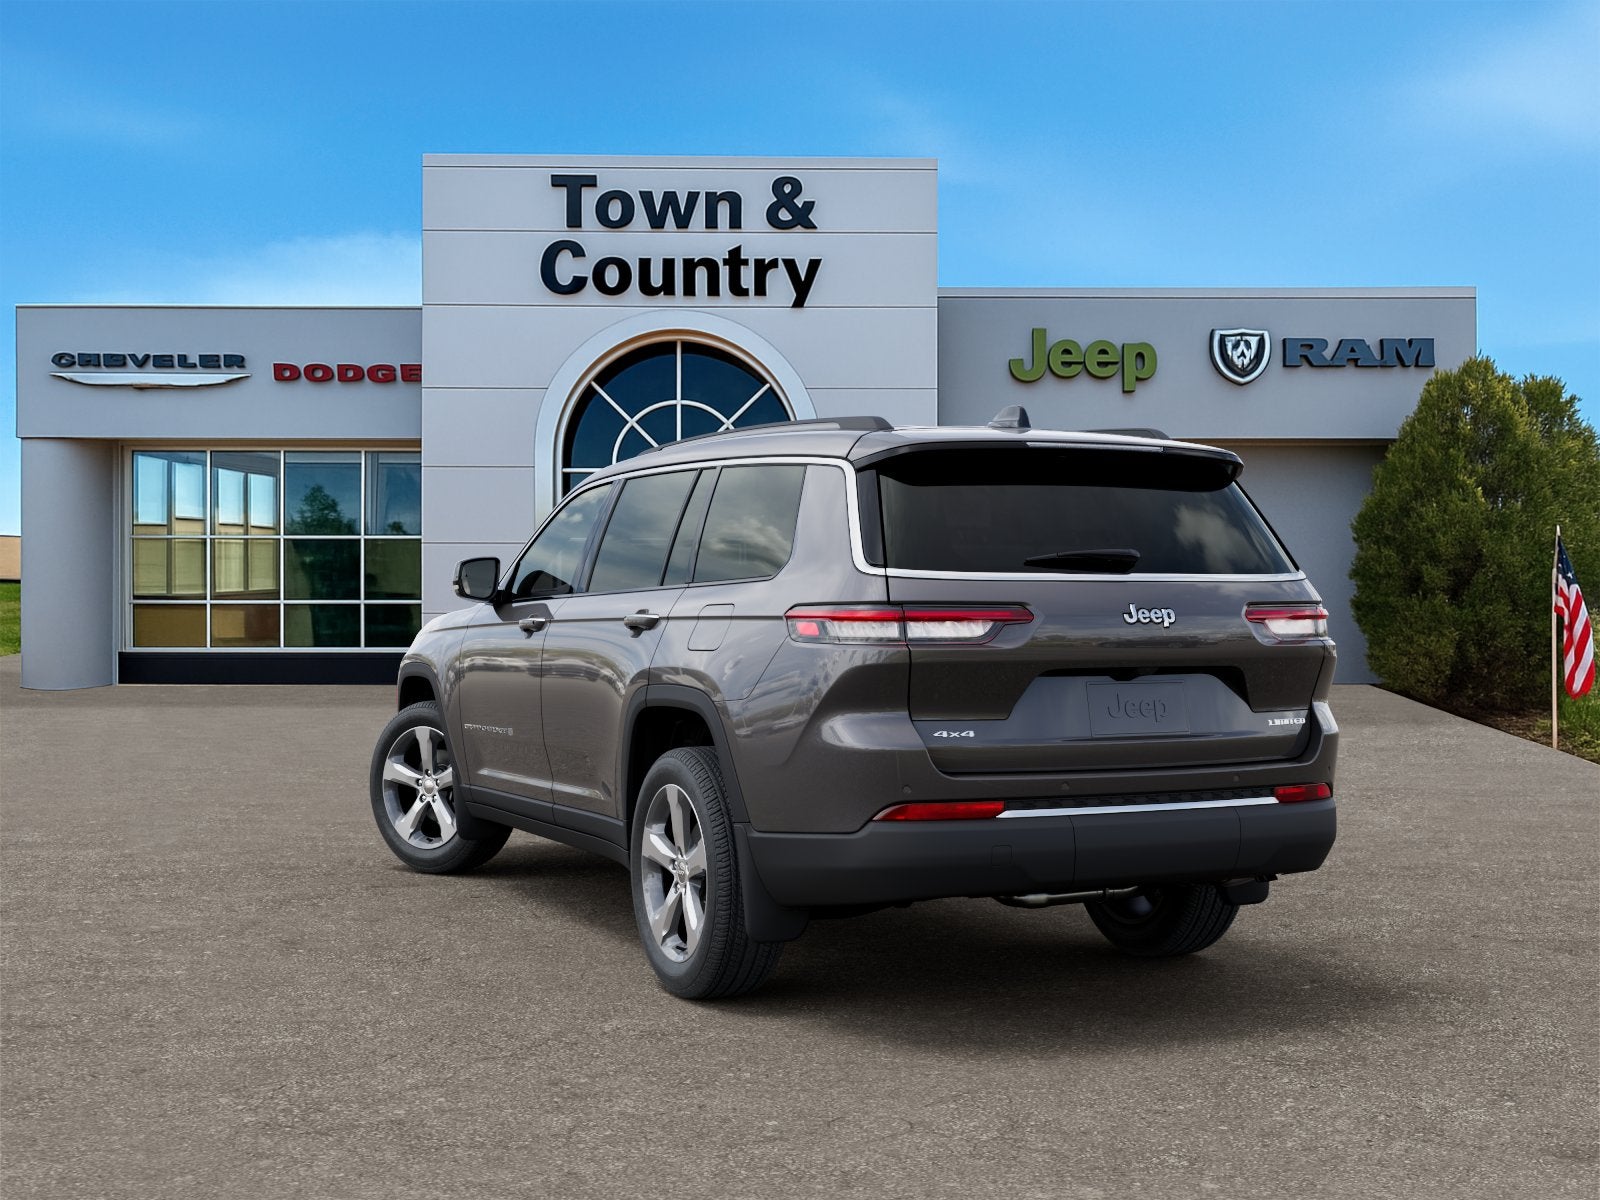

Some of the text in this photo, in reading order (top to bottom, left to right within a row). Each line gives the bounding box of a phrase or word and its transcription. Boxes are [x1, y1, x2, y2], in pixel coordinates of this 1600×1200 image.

[550, 174, 818, 230] Town &
[540, 239, 822, 308] Country
[1009, 327, 1158, 393] Jeep
[1282, 337, 1435, 368] RAM
[273, 363, 422, 383] DODGE
[1123, 603, 1176, 628] Jeep
[1107, 692, 1167, 723] Jeep
[932, 729, 976, 739] 4x4
